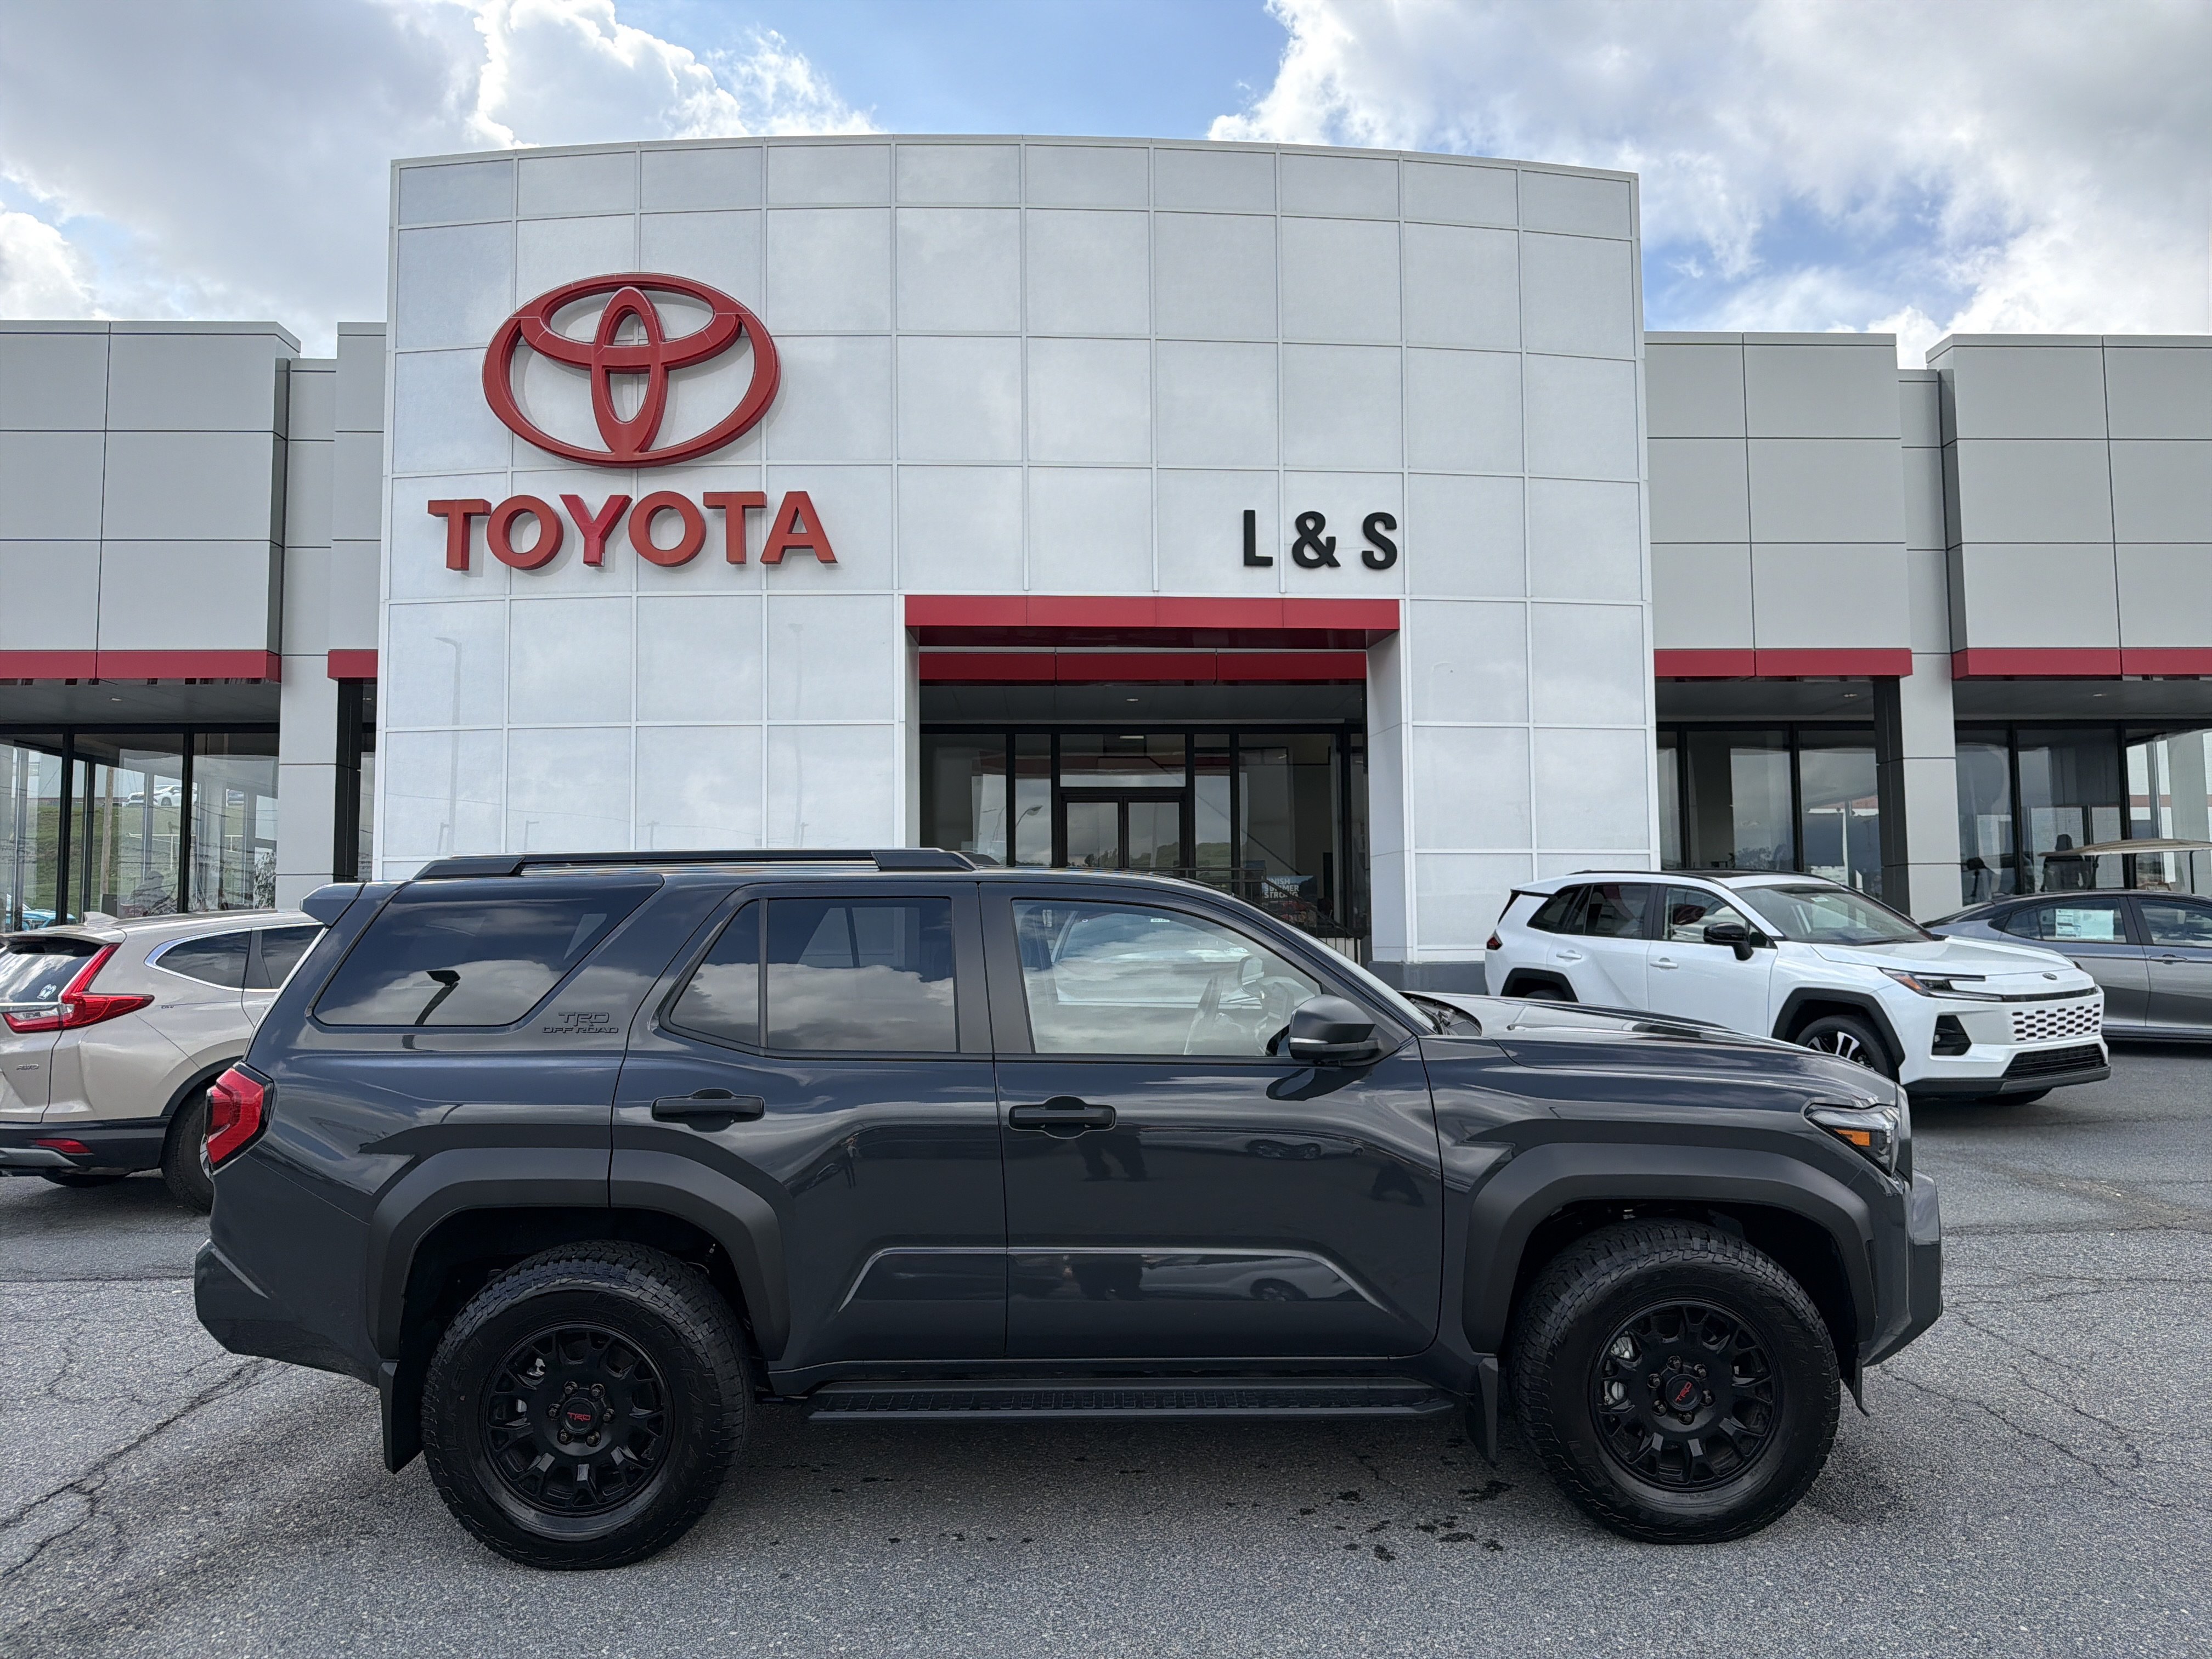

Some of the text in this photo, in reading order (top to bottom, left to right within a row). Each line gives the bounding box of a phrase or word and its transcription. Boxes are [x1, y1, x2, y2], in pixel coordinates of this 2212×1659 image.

[427, 490, 838, 571] TOYOTA
[1243, 510, 1398, 570] L & S
[558, 1012, 610, 1027] TRD
[1674, 1381, 1692, 1402] TRD
[567, 1412, 591, 1422] TRD
